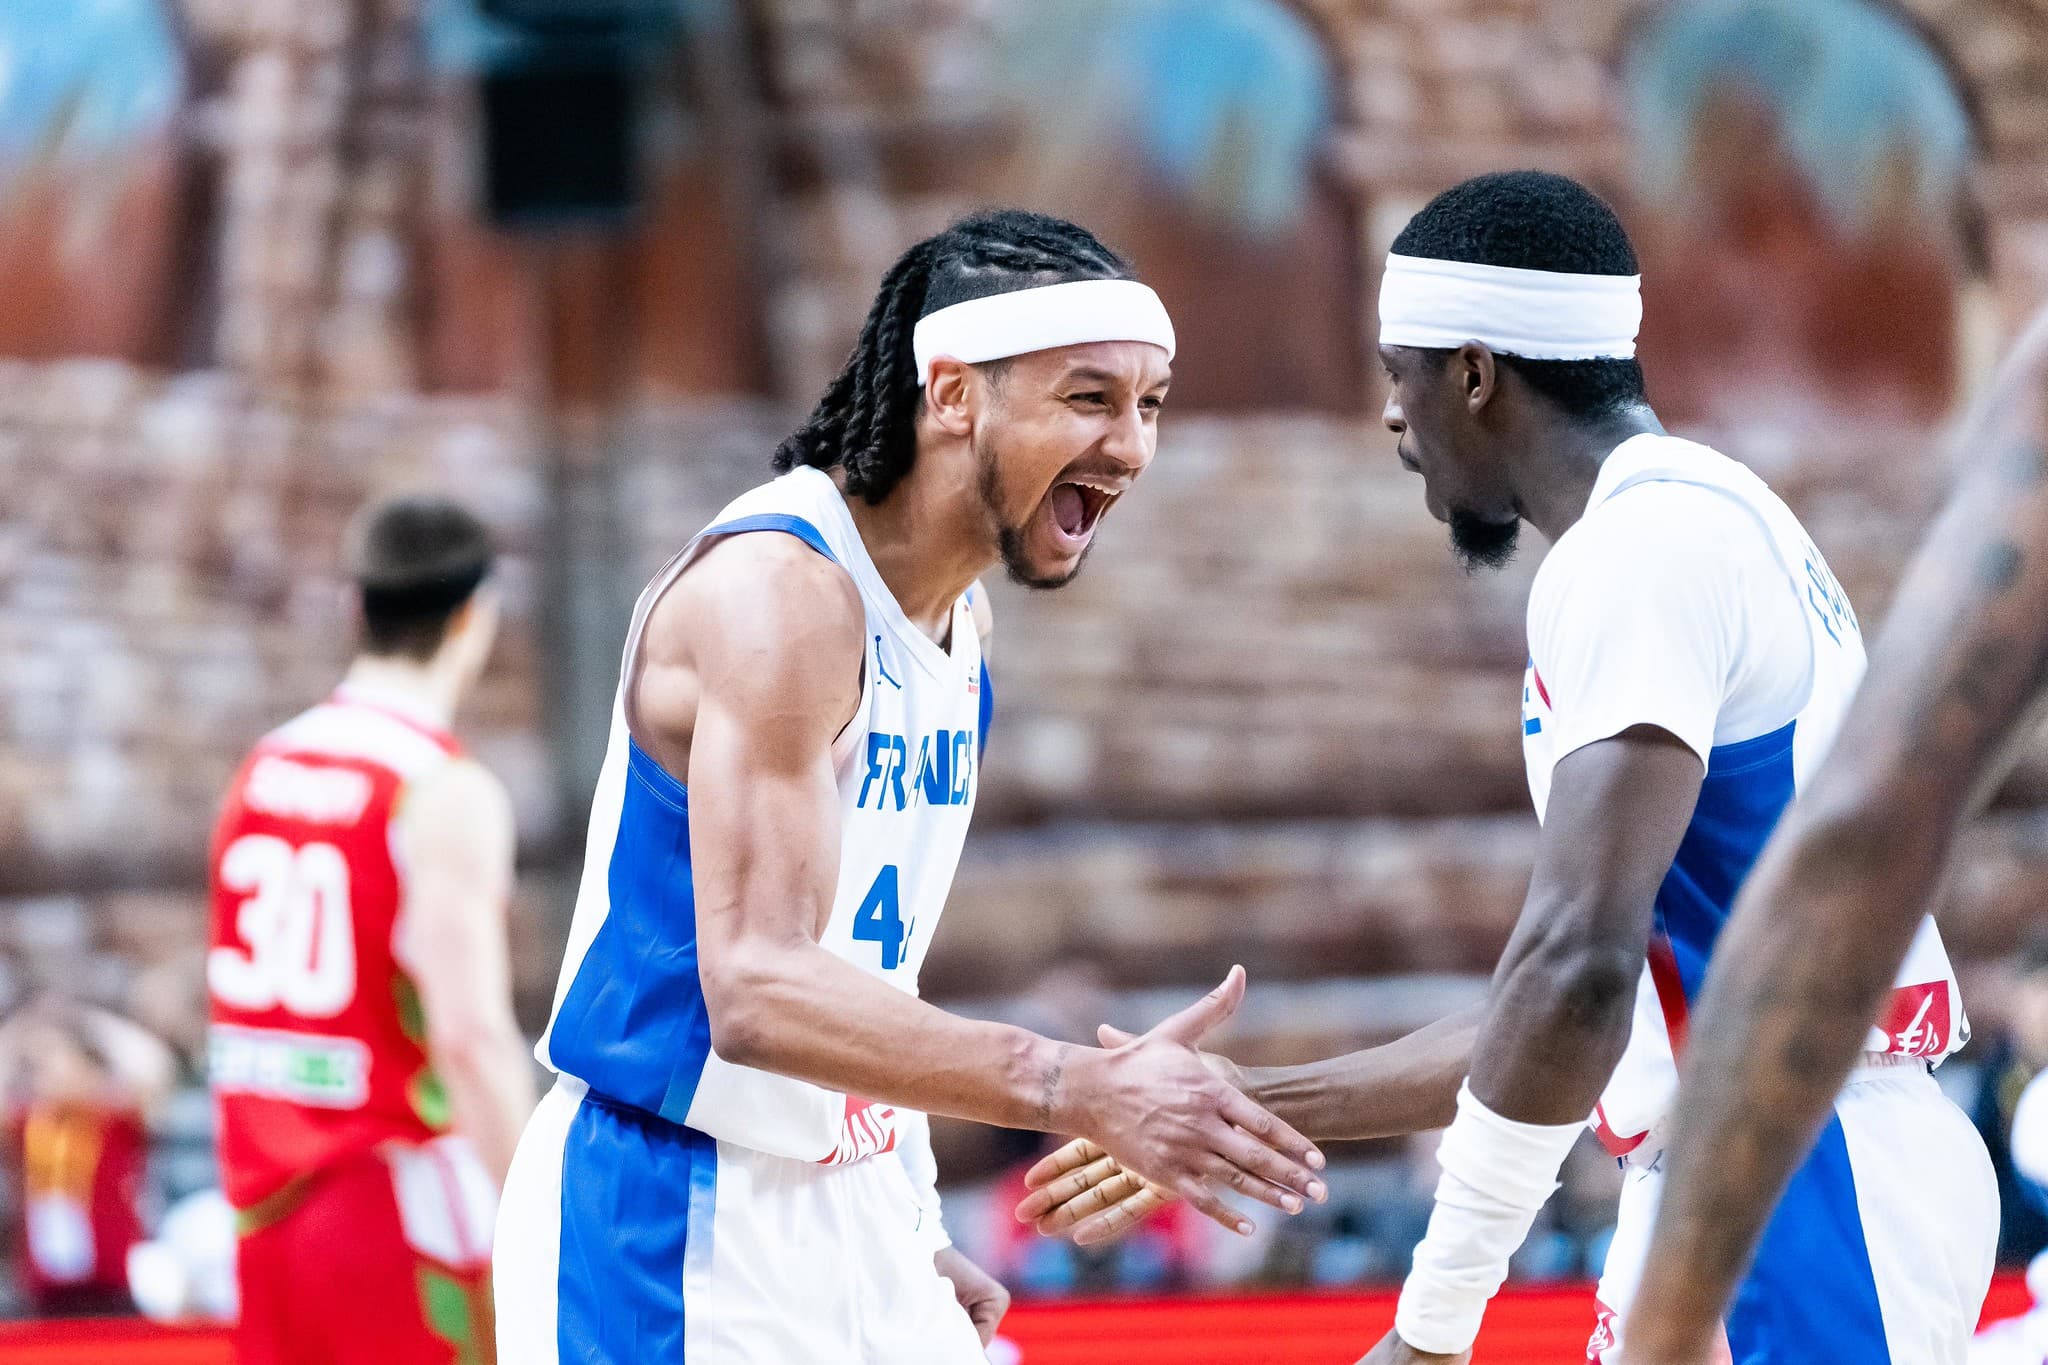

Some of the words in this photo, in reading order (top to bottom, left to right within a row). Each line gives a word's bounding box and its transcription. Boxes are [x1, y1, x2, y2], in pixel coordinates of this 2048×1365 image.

[857, 730, 972, 812] FRANC
[207, 833, 357, 1019] 30
[852, 864, 915, 970] 4
